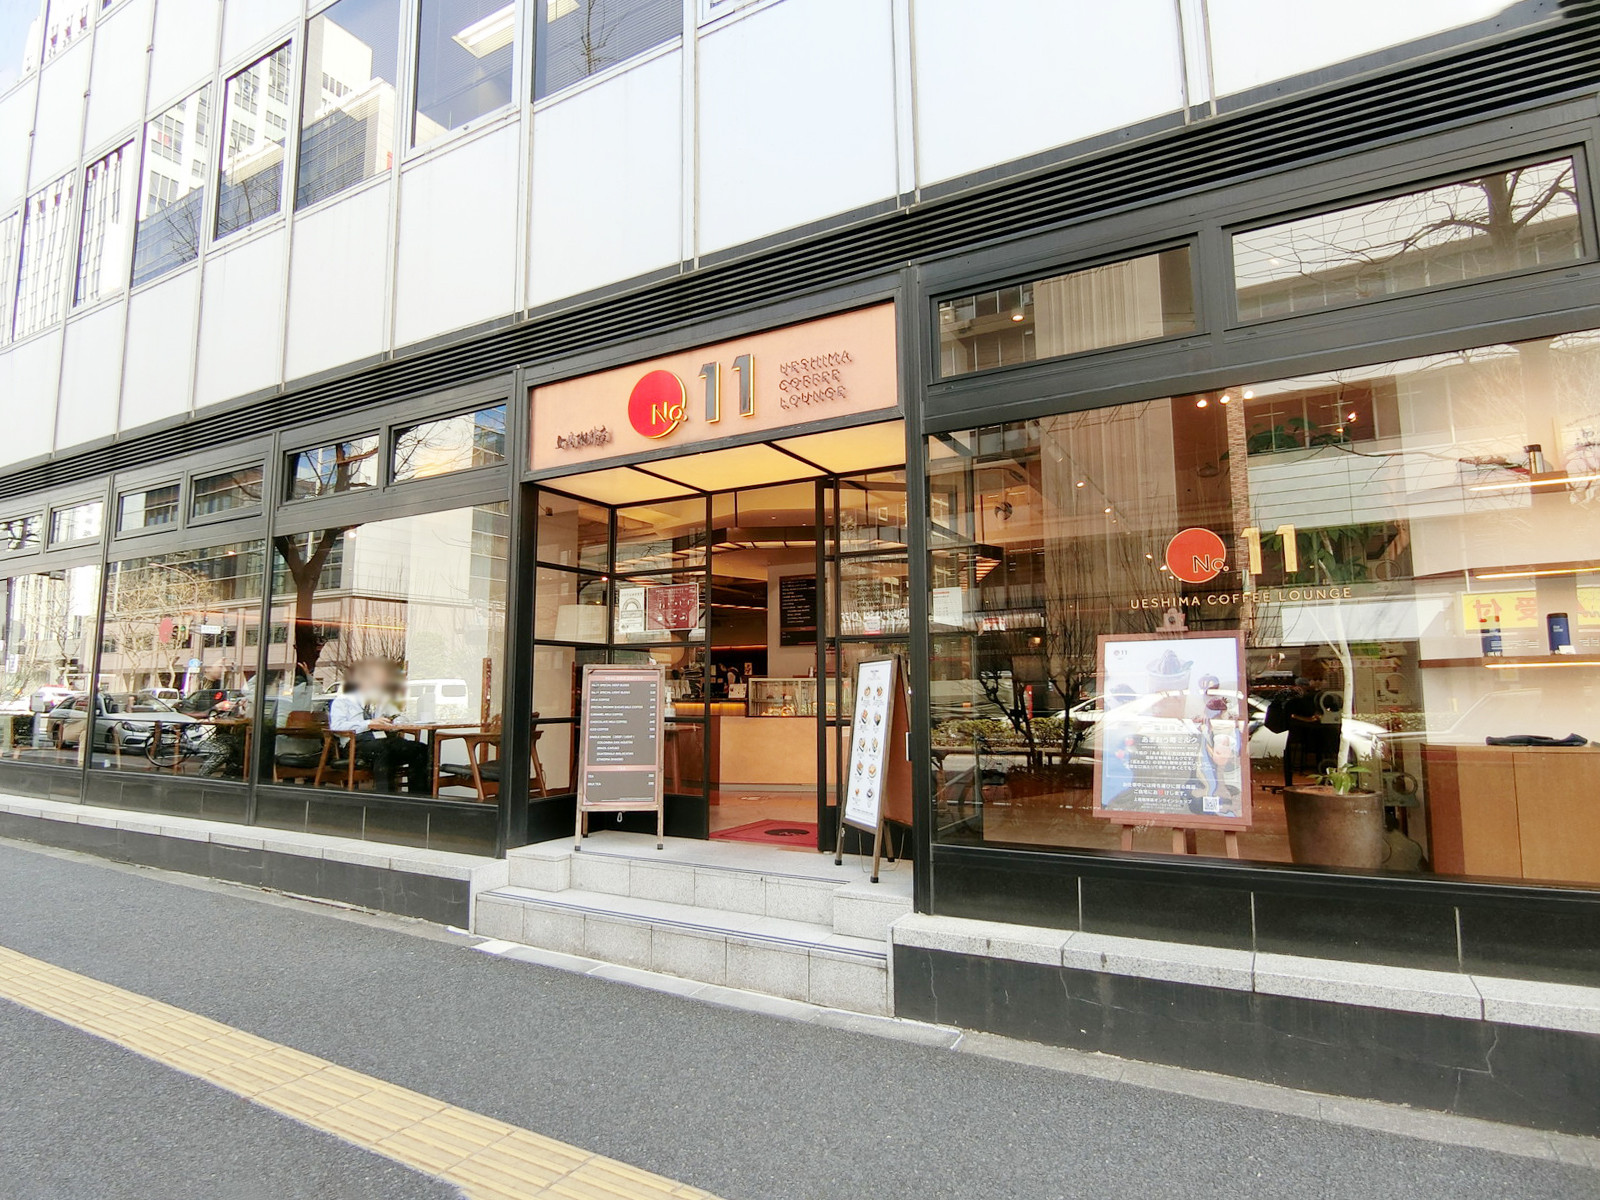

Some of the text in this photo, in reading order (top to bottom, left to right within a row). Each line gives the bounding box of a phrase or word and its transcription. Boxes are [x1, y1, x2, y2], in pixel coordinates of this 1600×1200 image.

[780, 350, 852, 376] UESHIMA
[652, 353, 755, 425] No. 11
[779, 369, 840, 393] COFFEE
[780, 385, 846, 410] LOUNGE
[1192, 523, 1298, 575] No. 11
[1130, 587, 1352, 609] UESHIMA COFFEE LOUNGE
